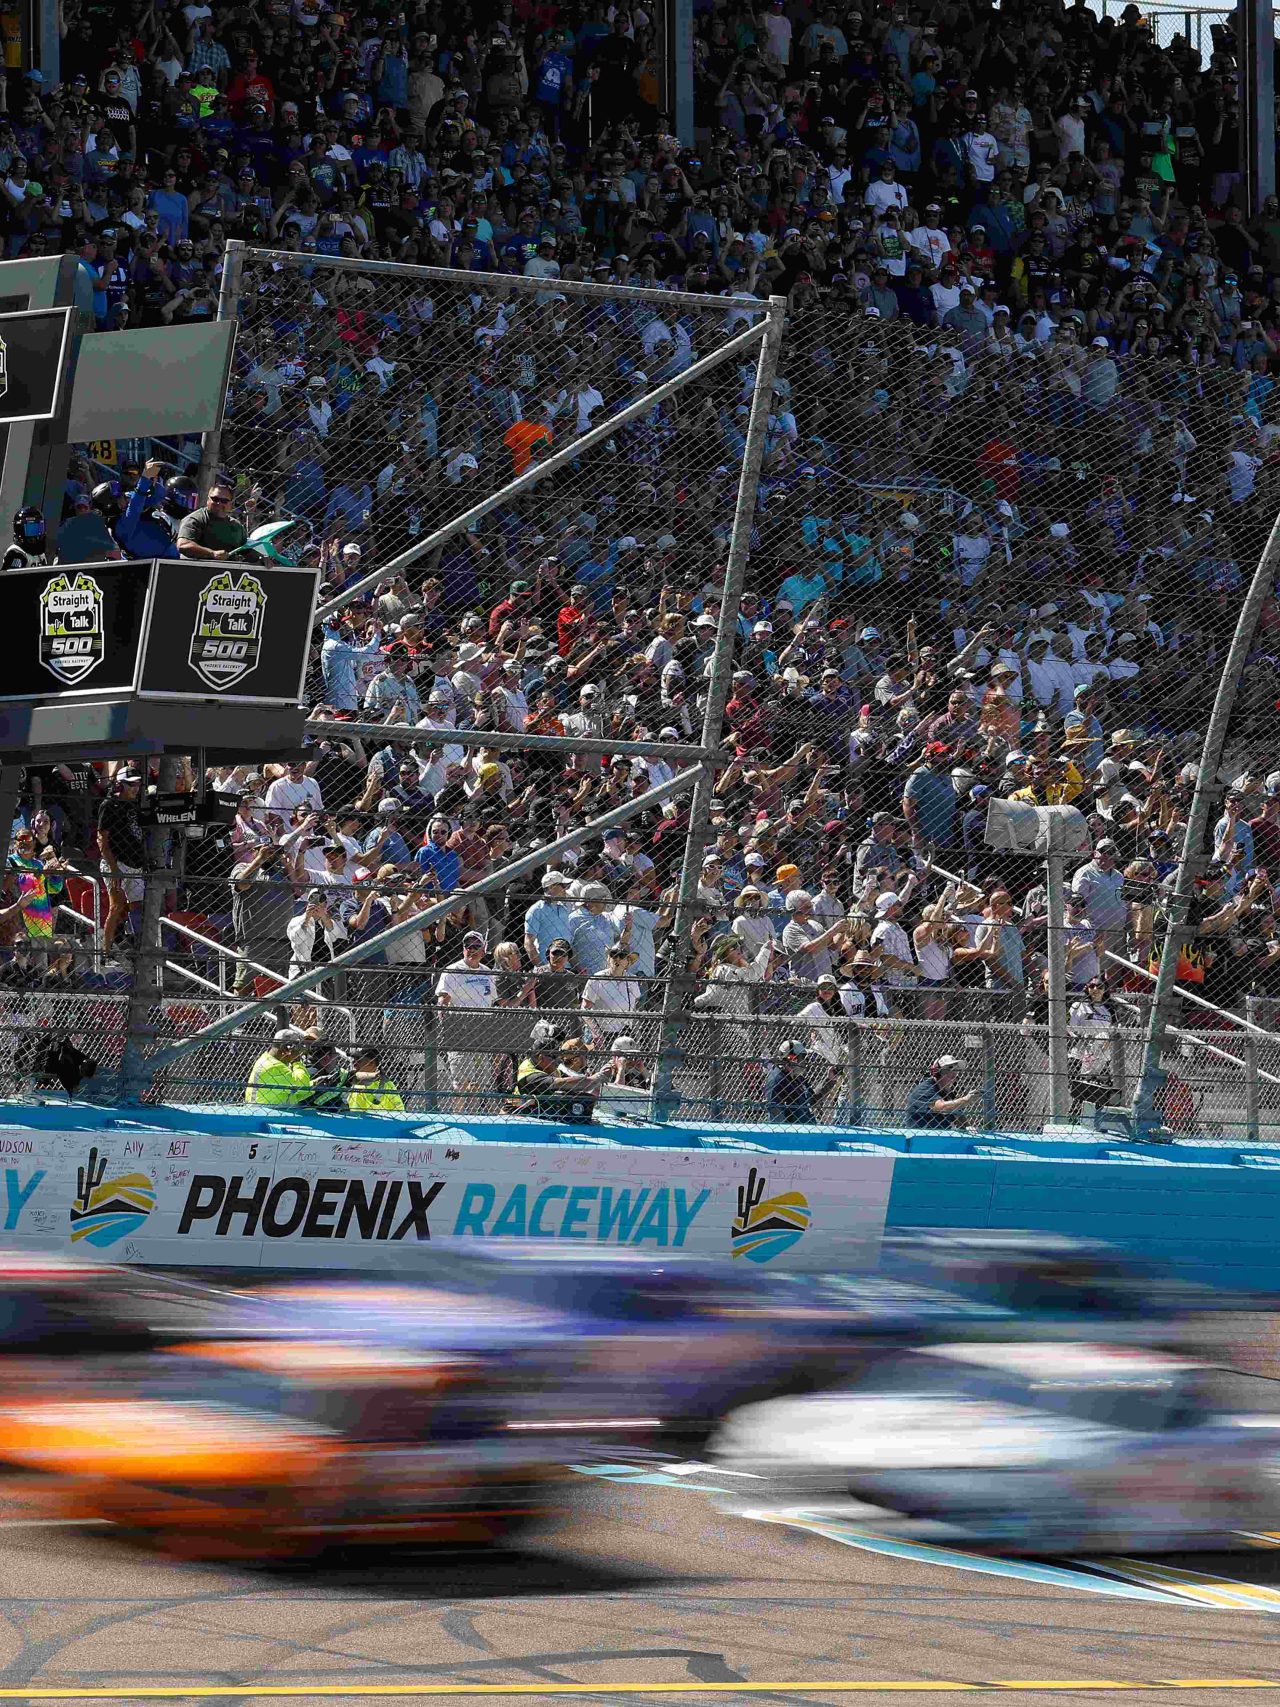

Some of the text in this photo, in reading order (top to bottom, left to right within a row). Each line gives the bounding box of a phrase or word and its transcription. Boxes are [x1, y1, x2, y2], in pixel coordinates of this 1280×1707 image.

[52, 594, 89, 608] Straight
[212, 594, 251, 609] Straight
[70, 616, 89, 628] Talk
[227, 618, 248, 631] Talk
[51, 637, 93, 655] 500
[201, 640, 249, 659] 500
[156, 810, 196, 823] WHELEN
[123, 1141, 144, 1158] Ally
[248, 1143, 258, 1159] 5
[177, 1174, 711, 1246] PHOENIX RACEWAY
